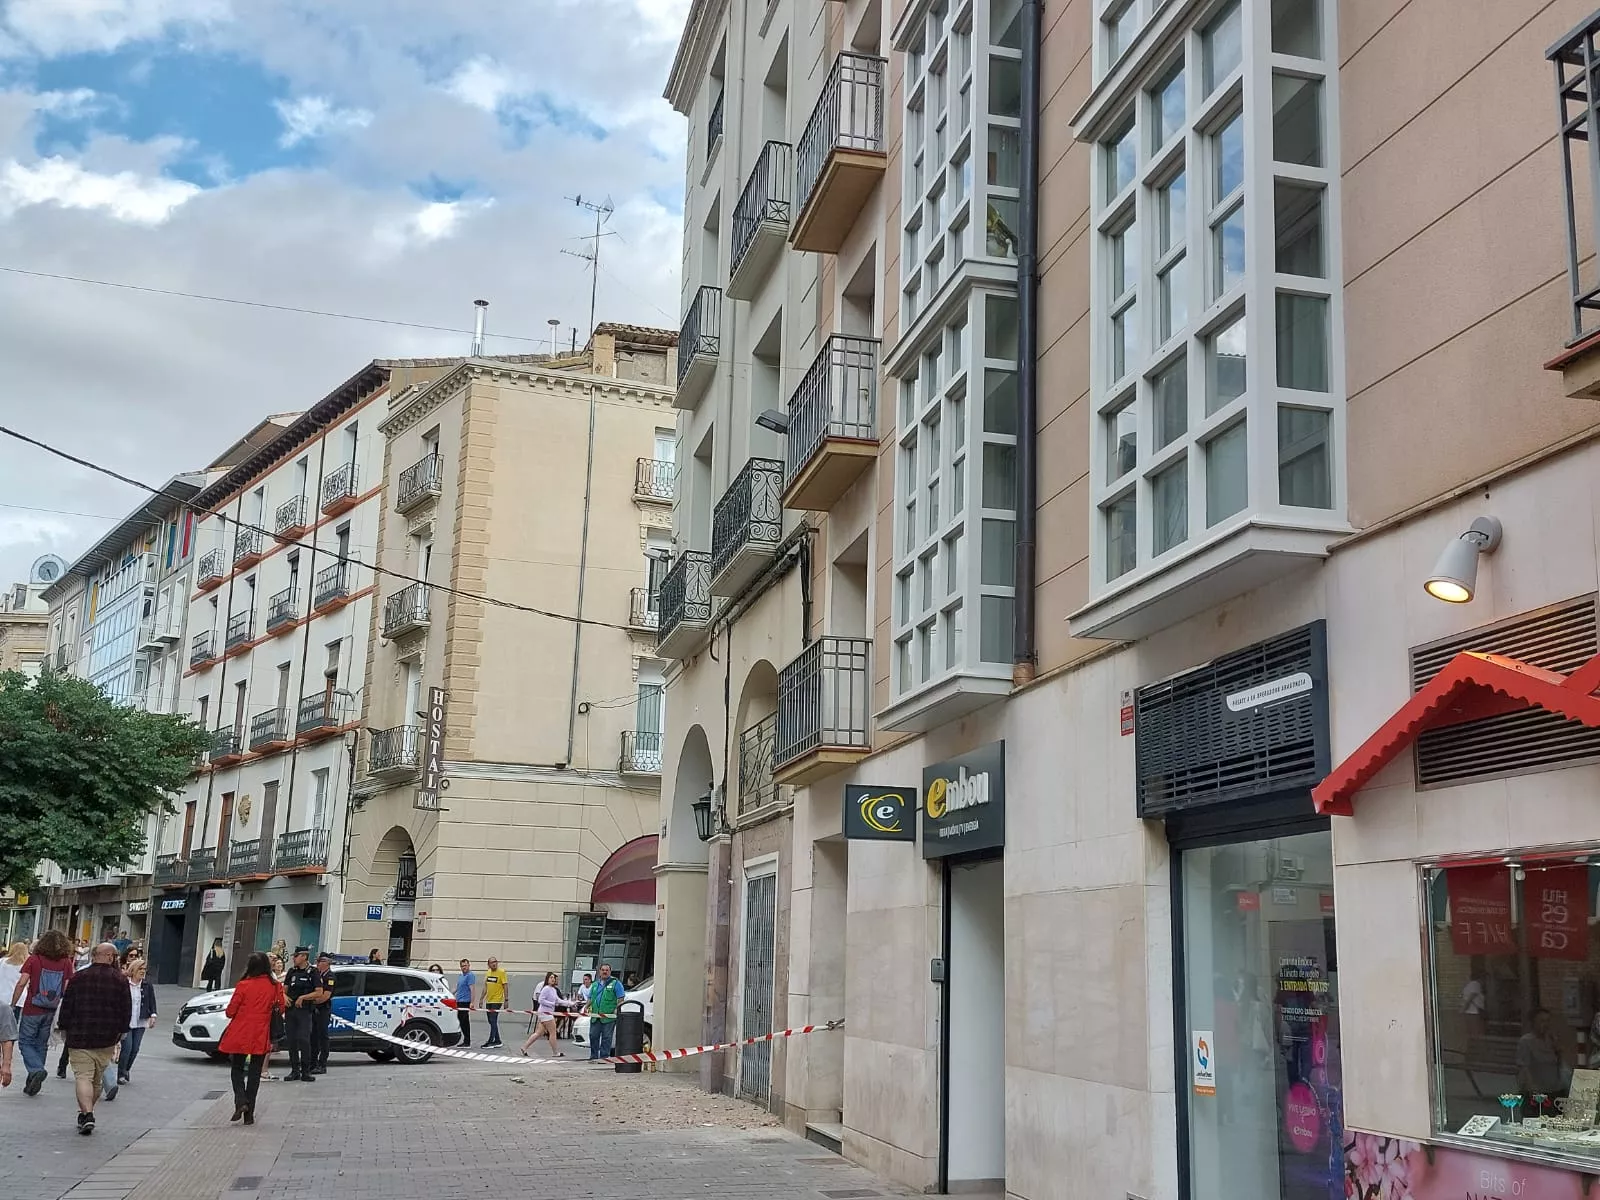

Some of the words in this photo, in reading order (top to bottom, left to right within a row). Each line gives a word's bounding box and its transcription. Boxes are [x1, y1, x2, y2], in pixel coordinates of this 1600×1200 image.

[427, 689, 444, 789] HOSTAL
[927, 766, 990, 819] embou
[369, 906, 381, 915] HS
[1284, 980, 1307, 991] ENTRADA
[1480, 1170, 1505, 1193] Bits
[1511, 1178, 1527, 1196] of
